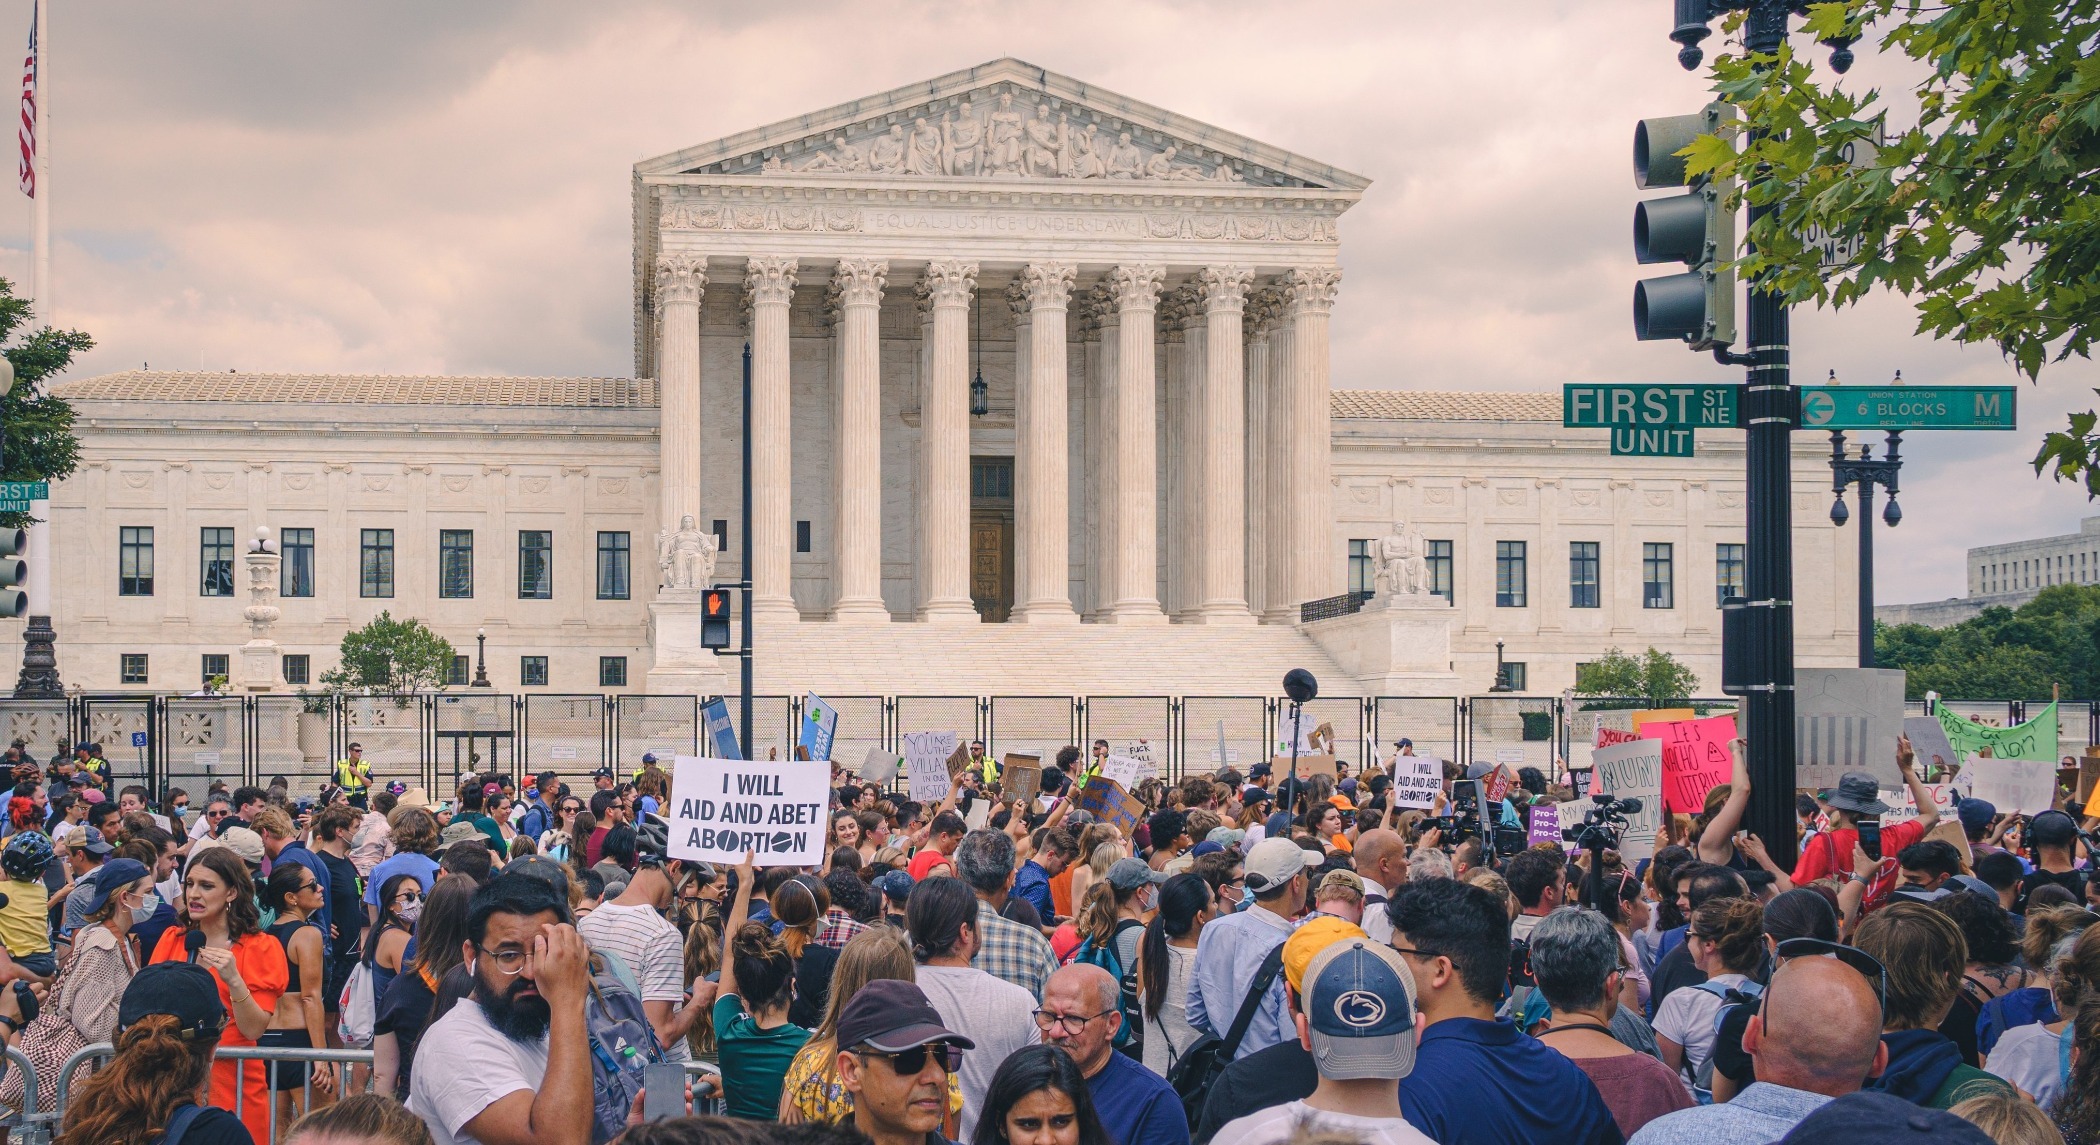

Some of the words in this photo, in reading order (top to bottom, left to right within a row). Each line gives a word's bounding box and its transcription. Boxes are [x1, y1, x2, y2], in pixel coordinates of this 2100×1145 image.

[876, 214, 938, 229] EQUAL
[943, 214, 1016, 231] JUSTICE
[1027, 216, 1089, 232] UNDER
[1095, 217, 1130, 232] LAW
[1572, 388, 1695, 424] FIRST
[1703, 390, 1727, 406] ST
[1857, 402, 1867, 415] 6
[1877, 403, 1946, 415] BLOCKS
[1974, 393, 2000, 417] M
[1702, 408, 1730, 424] NE
[1616, 429, 1690, 453] UNIT
[0, 484, 31, 499] RST
[0, 500, 28, 511] UNIT
[1603, 729, 1622, 743] YOU
[907, 734, 933, 755] YOU
[935, 735, 952, 745] ARE
[934, 746, 952, 755] THE
[1129, 745, 1151, 754] FUCK
[1950, 735, 2036, 762] Abtion
[1662, 744, 1699, 772] NACHO
[1413, 763, 1418, 773] I
[1418, 764, 1432, 775] WILL
[722, 773, 729, 794] I
[737, 774, 784, 796] WILL
[1398, 776, 1410, 787] AID
[1411, 777, 1426, 788] AND
[1426, 778, 1441, 789] ABET
[916, 784, 950, 799] HISTOR
[1399, 791, 1438, 802] ABORTION
[680, 798, 715, 821] AID
[720, 802, 763, 824] AND
[767, 803, 820, 825] ABET
[1562, 806, 1576, 821] MY
[687, 827, 807, 853] ABORTION
